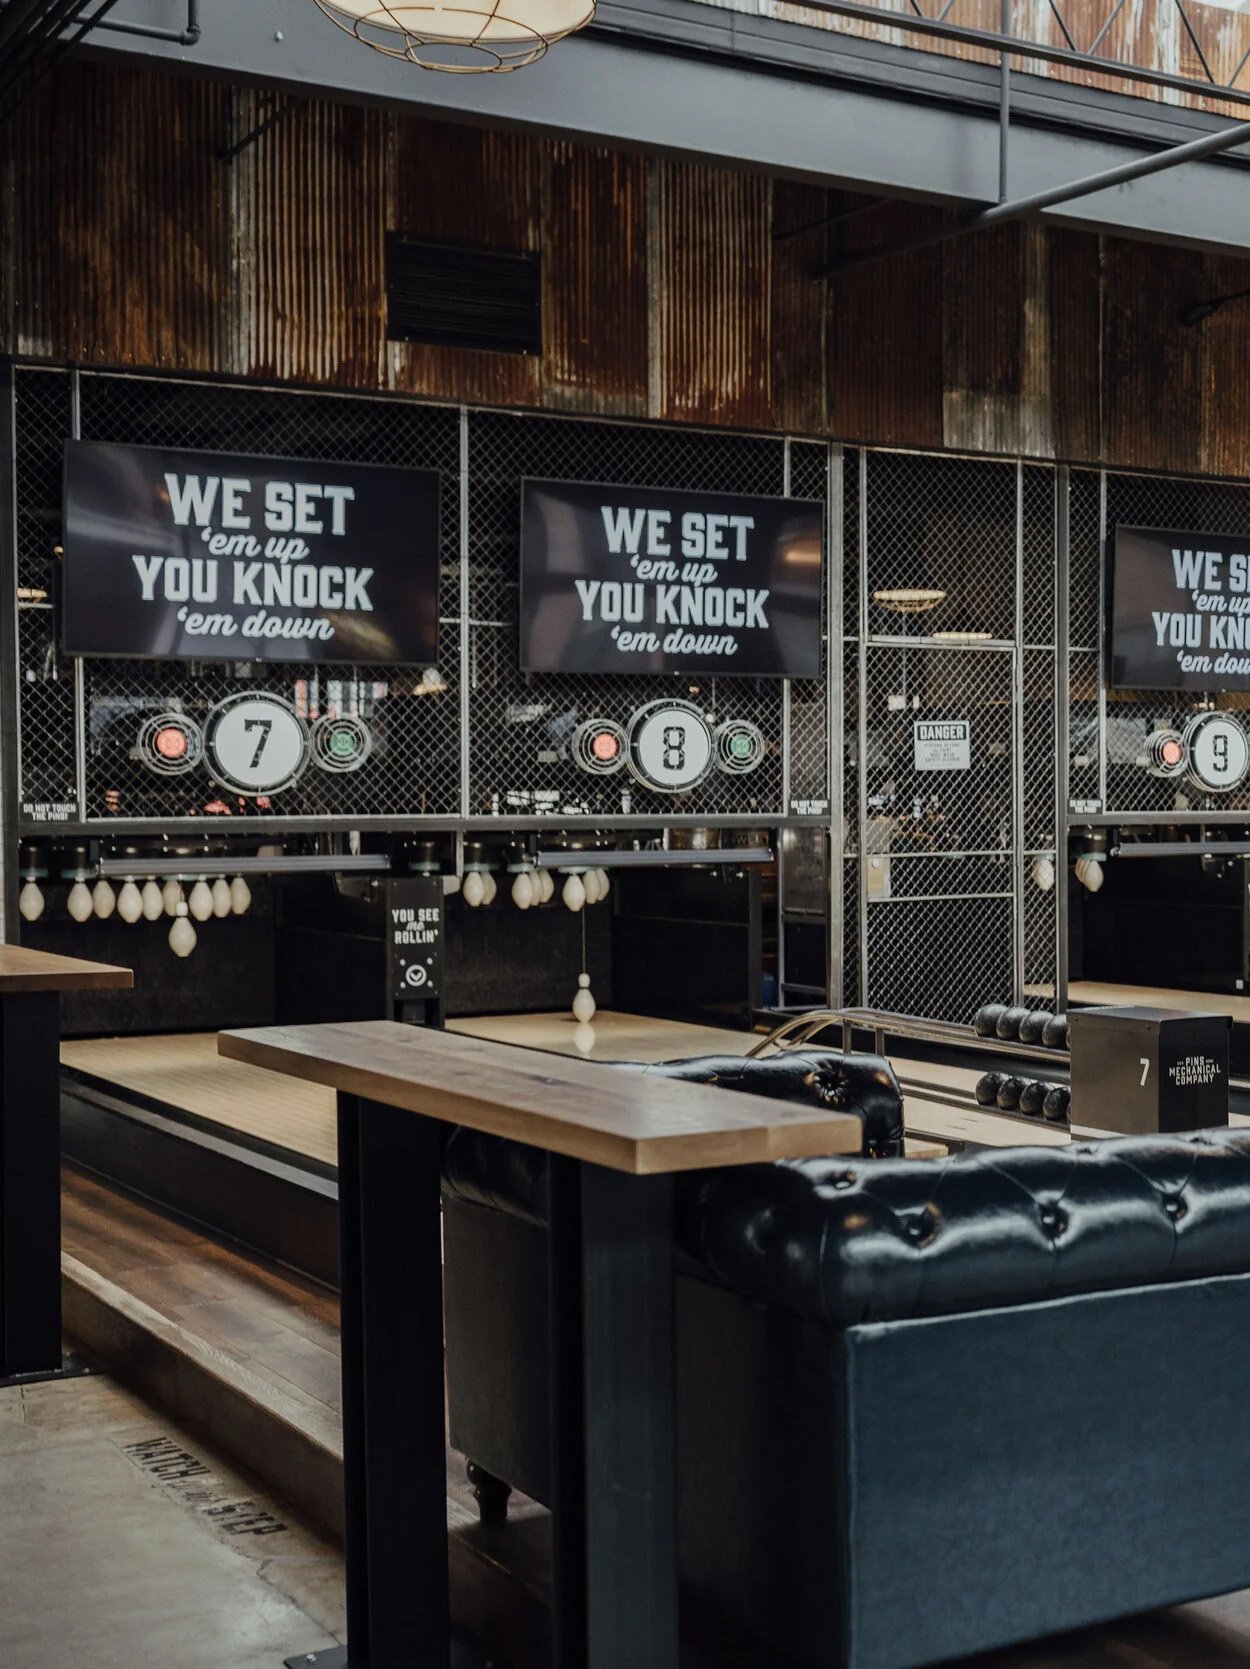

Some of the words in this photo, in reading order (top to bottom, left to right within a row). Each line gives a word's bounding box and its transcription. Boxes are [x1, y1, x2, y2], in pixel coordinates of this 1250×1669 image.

[164, 473, 251, 529] WE
[264, 481, 355, 536] SET
[601, 506, 672, 556] WE
[681, 512, 755, 561] SET
[264, 536, 310, 564] up
[132, 555, 218, 603] YOU
[233, 560, 374, 611] KNOCK
[681, 562, 718, 587] up
[1172, 549, 1223, 591] WE
[575, 580, 645, 623] YOU
[656, 584, 770, 628] KNOCK
[242, 610, 335, 640] down
[1152, 611, 1202, 648] YOU
[663, 628, 738, 655] down
[244, 719, 272, 768] 7
[920, 725, 964, 740] DANGER
[663, 726, 686, 770] 8
[1213, 735, 1228, 772] 9
[392, 909, 414, 923] YOU
[418, 908, 439, 922] SEE
[394, 929, 439, 944] ROLLIN'
[1140, 1058, 1150, 1086] 7
[1169, 1063, 1221, 1077] MECHANICAL
[1185, 1056, 1204, 1066] PINS
[1175, 1073, 1214, 1085] COMPANY
